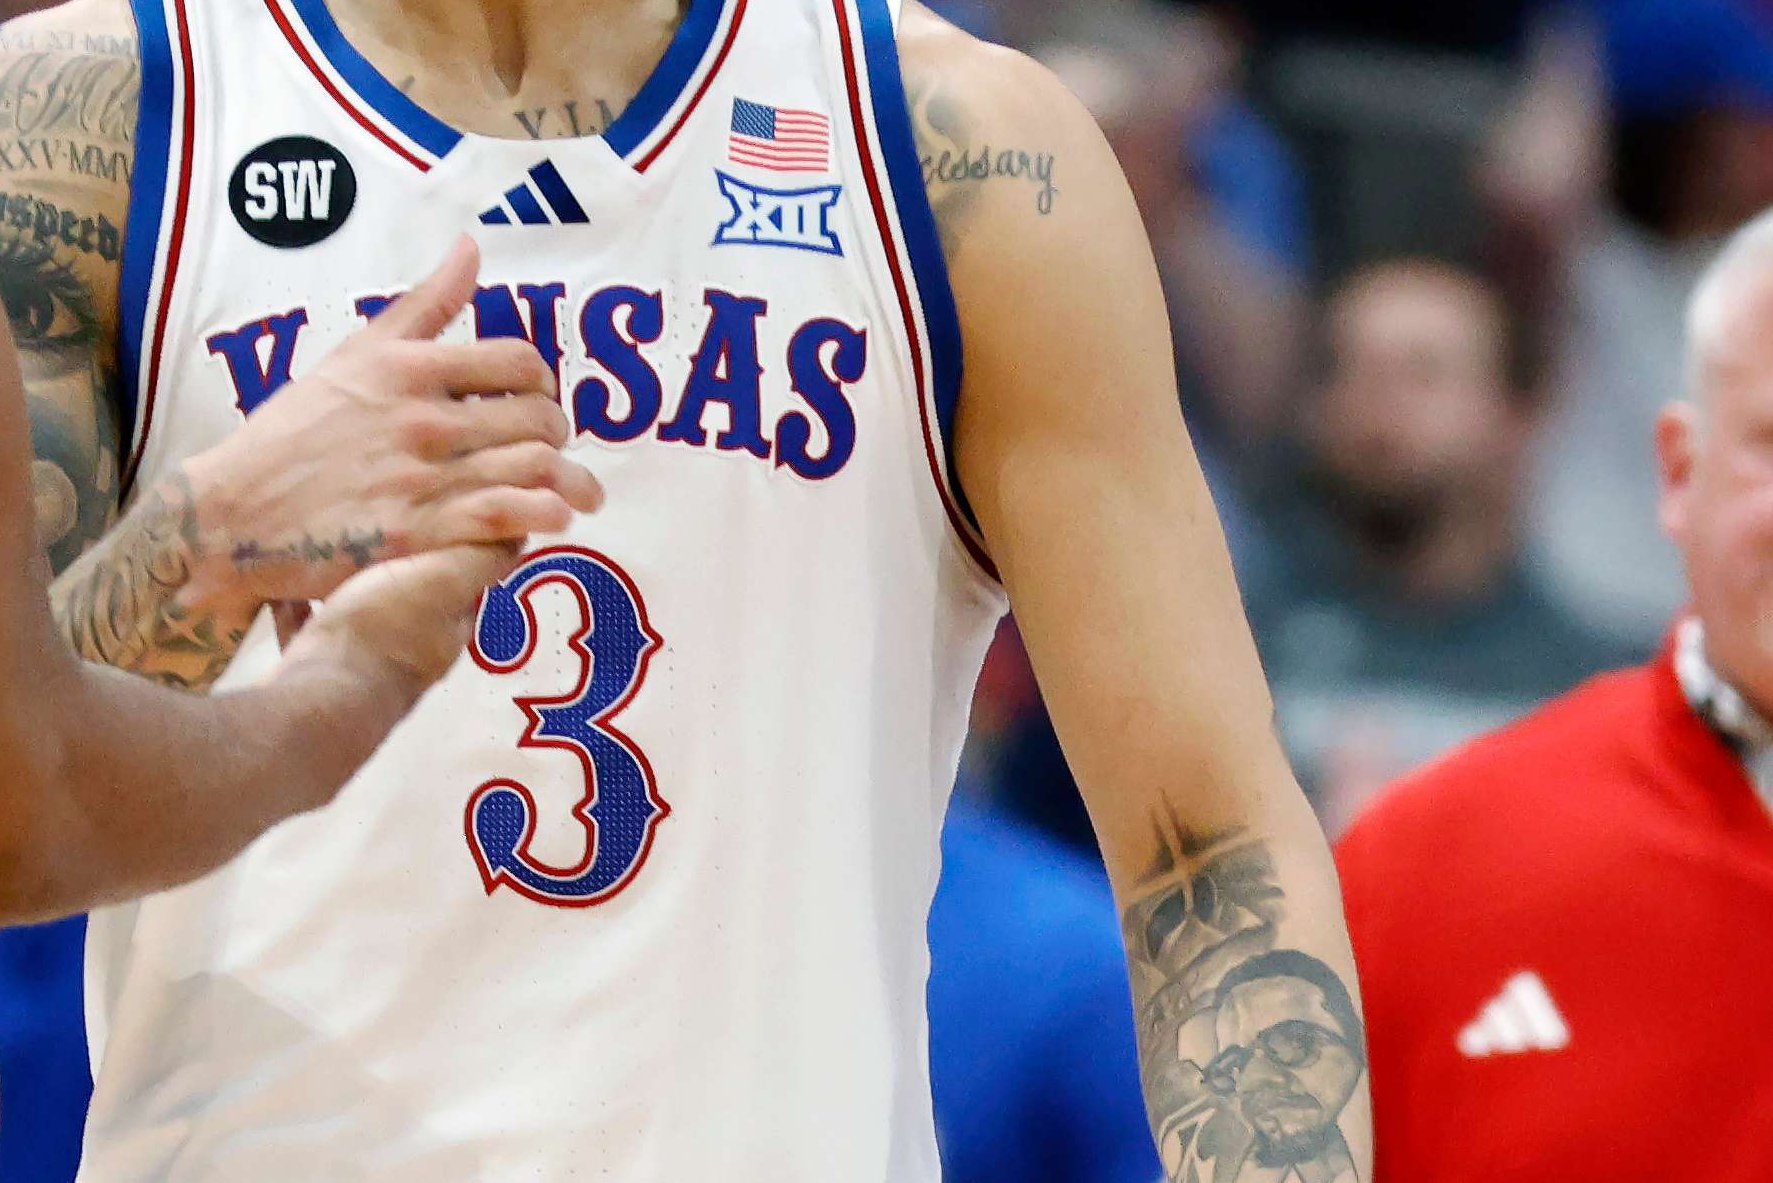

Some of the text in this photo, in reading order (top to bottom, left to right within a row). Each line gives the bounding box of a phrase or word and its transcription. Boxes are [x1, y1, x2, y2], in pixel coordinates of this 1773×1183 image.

[244, 159, 337, 221] SW
[710, 168, 845, 258] XII
[206, 281, 868, 482] KNSAS
[464, 545, 673, 909] 3
